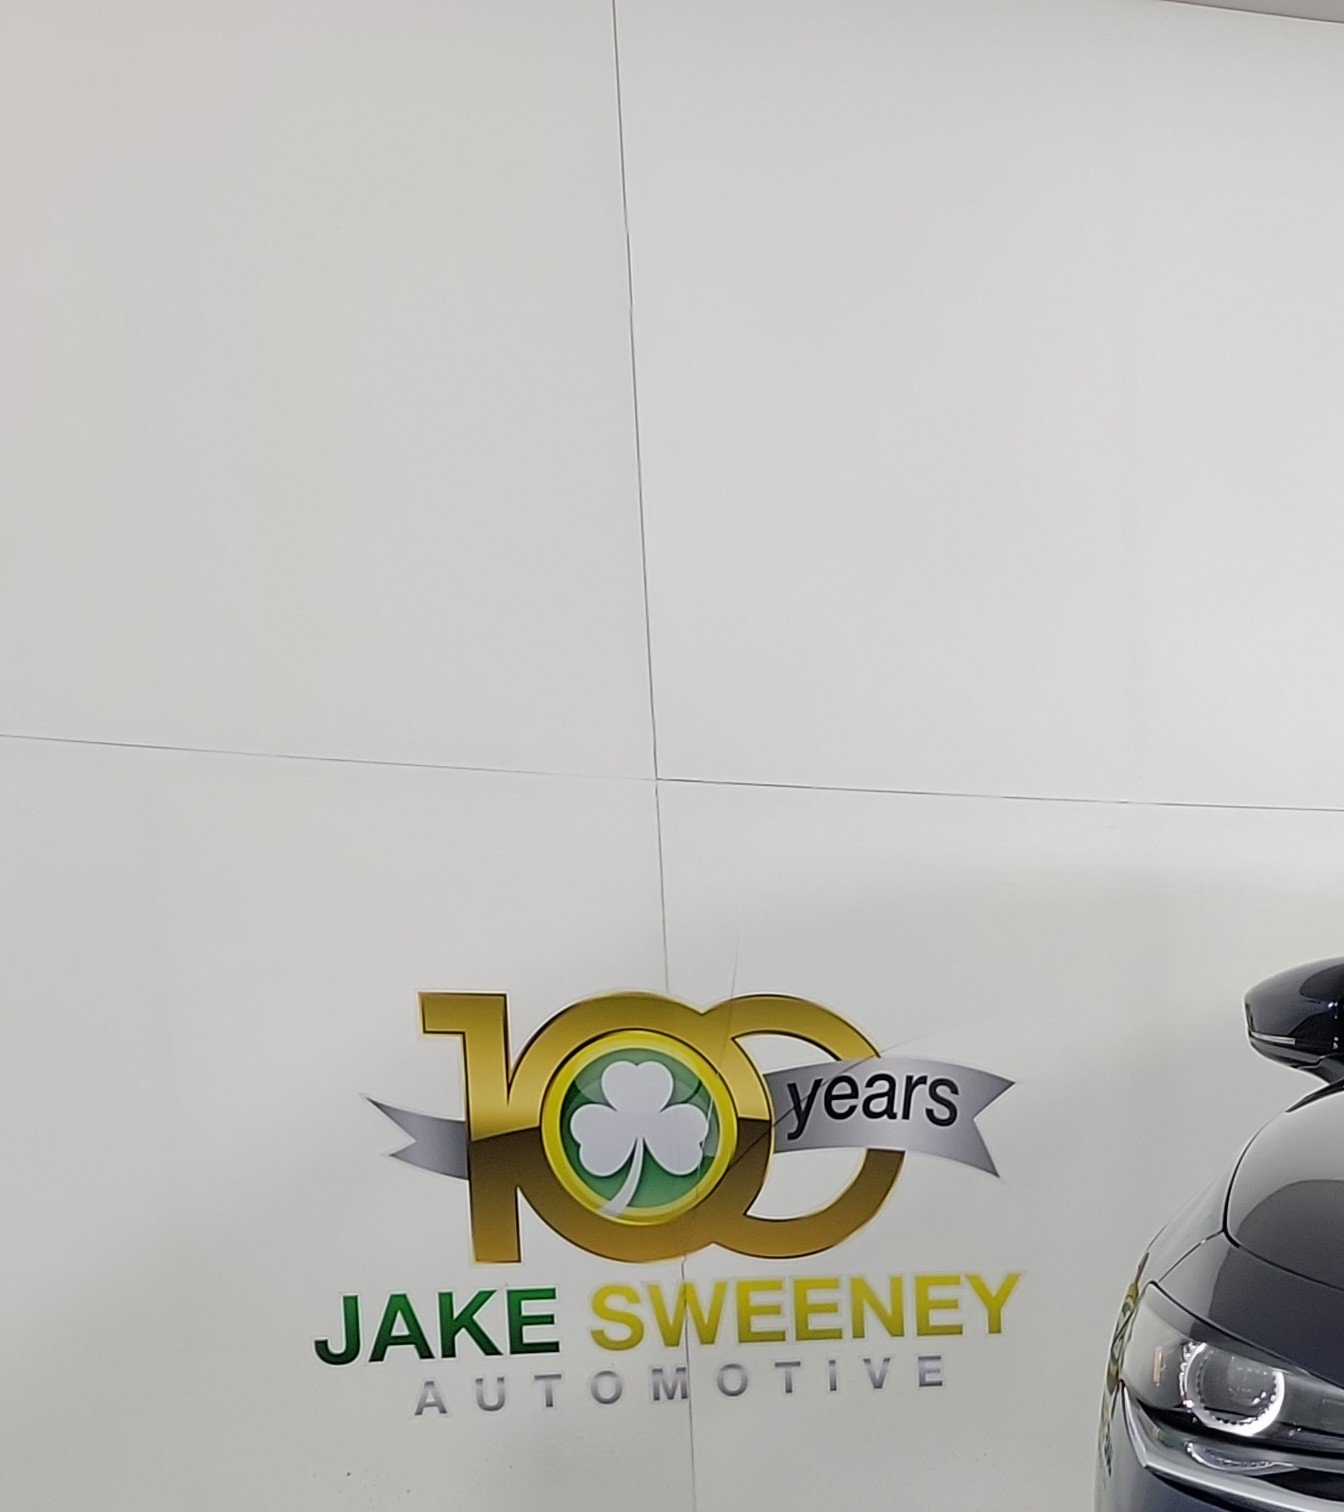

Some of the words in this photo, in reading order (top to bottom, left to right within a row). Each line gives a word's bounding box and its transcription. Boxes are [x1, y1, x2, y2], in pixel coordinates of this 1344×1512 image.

[418, 991, 905, 1264] 100
[786, 1071, 961, 1140] years
[313, 1286, 560, 1366] JAKE
[588, 1272, 1022, 1352] SWEENEY
[413, 1354, 945, 1417] AUTOMOTIVE
